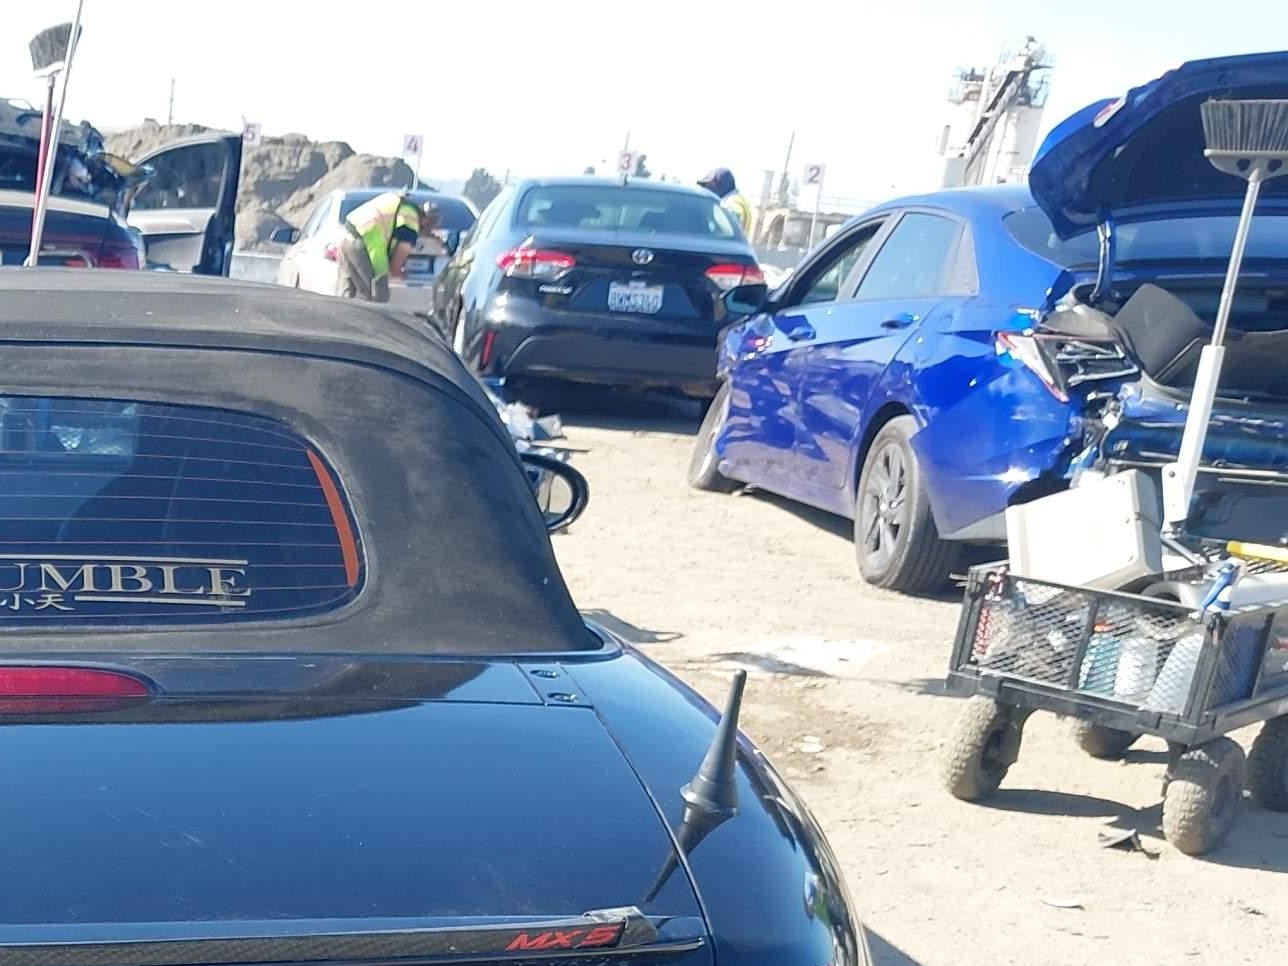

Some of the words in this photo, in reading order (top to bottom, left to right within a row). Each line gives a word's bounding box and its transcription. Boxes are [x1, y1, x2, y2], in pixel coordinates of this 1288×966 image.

[244, 124, 256, 142] 5
[406, 136, 418, 153] 4
[621, 153, 632, 171] 3
[807, 165, 821, 184] 2
